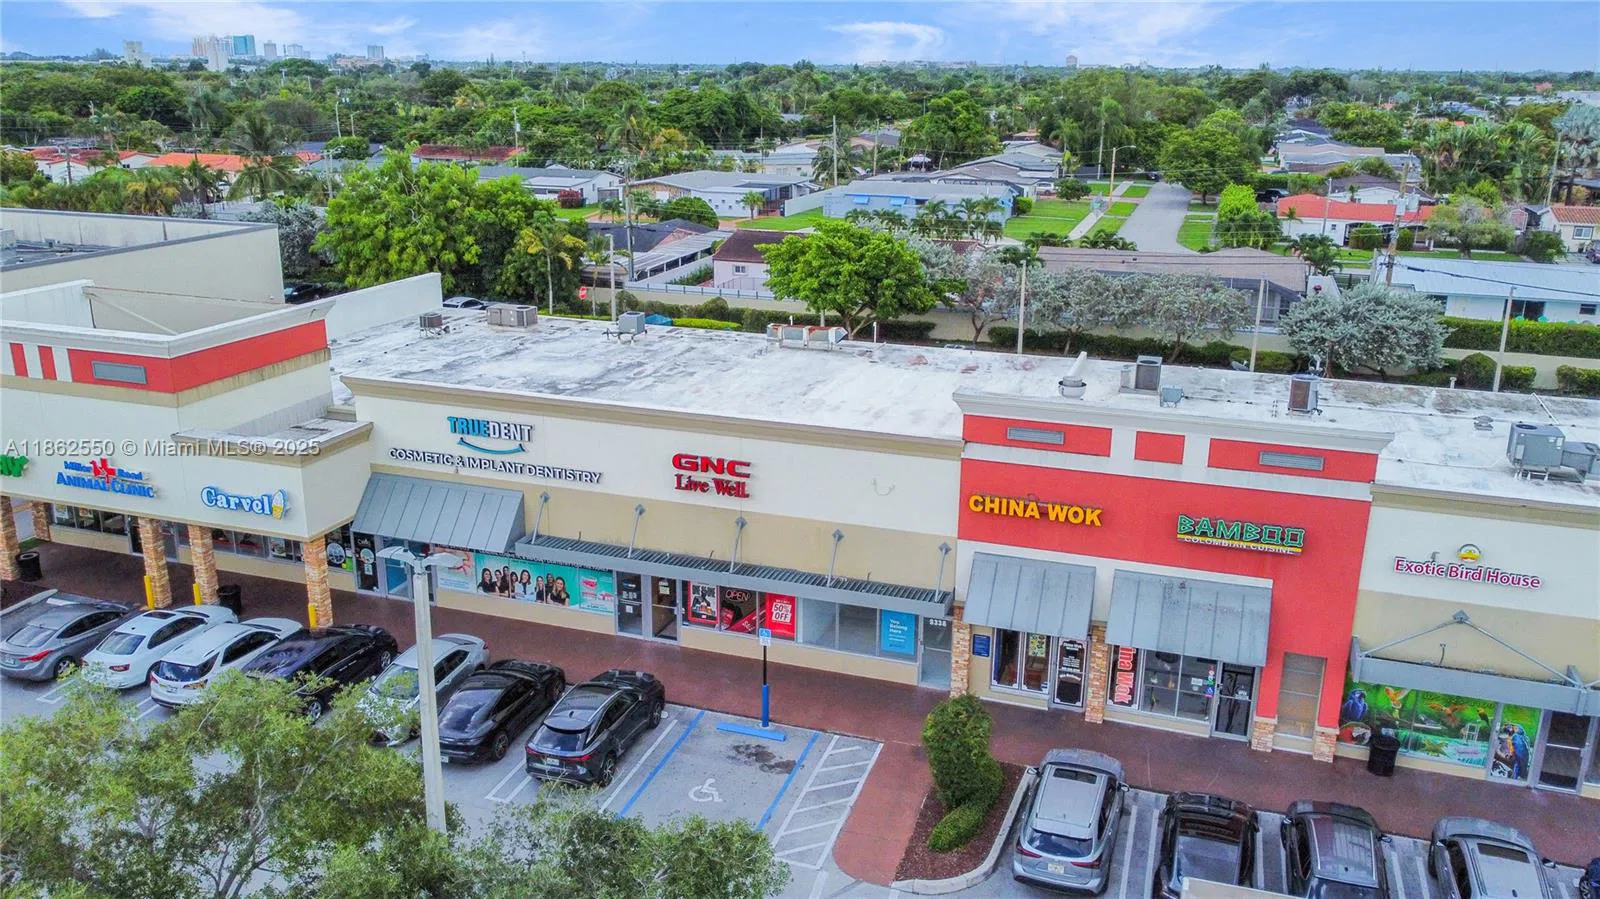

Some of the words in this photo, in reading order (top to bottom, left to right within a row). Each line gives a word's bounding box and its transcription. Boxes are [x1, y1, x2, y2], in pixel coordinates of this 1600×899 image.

[447, 416, 533, 442] TRUEDENT
[117, 468, 144, 480] Road
[389, 449, 453, 466] COSMETIC
[455, 456, 465, 468] &
[466, 457, 524, 476] IMPLANT
[527, 465, 602, 485] DENTISTRY
[672, 452, 751, 478] GNC
[56, 471, 110, 492] ANIMAL
[111, 478, 155, 498] CLINIC
[674, 473, 709, 493] Live
[201, 486, 272, 516] Carvel
[968, 494, 1041, 520] CHINA
[1047, 502, 1103, 526] WOK
[1177, 514, 1305, 547] BAMBOO
[1184, 535, 1247, 549] COLOMBIAN
[1249, 544, 1294, 555] CUISINE
[1394, 556, 1445, 577] Exotic
[1447, 564, 1483, 582] Bird
[1486, 567, 1542, 589] House
[725, 590, 750, 602] OPEN
[773, 603, 791, 613] 50%
[774, 611, 790, 621] OFF
